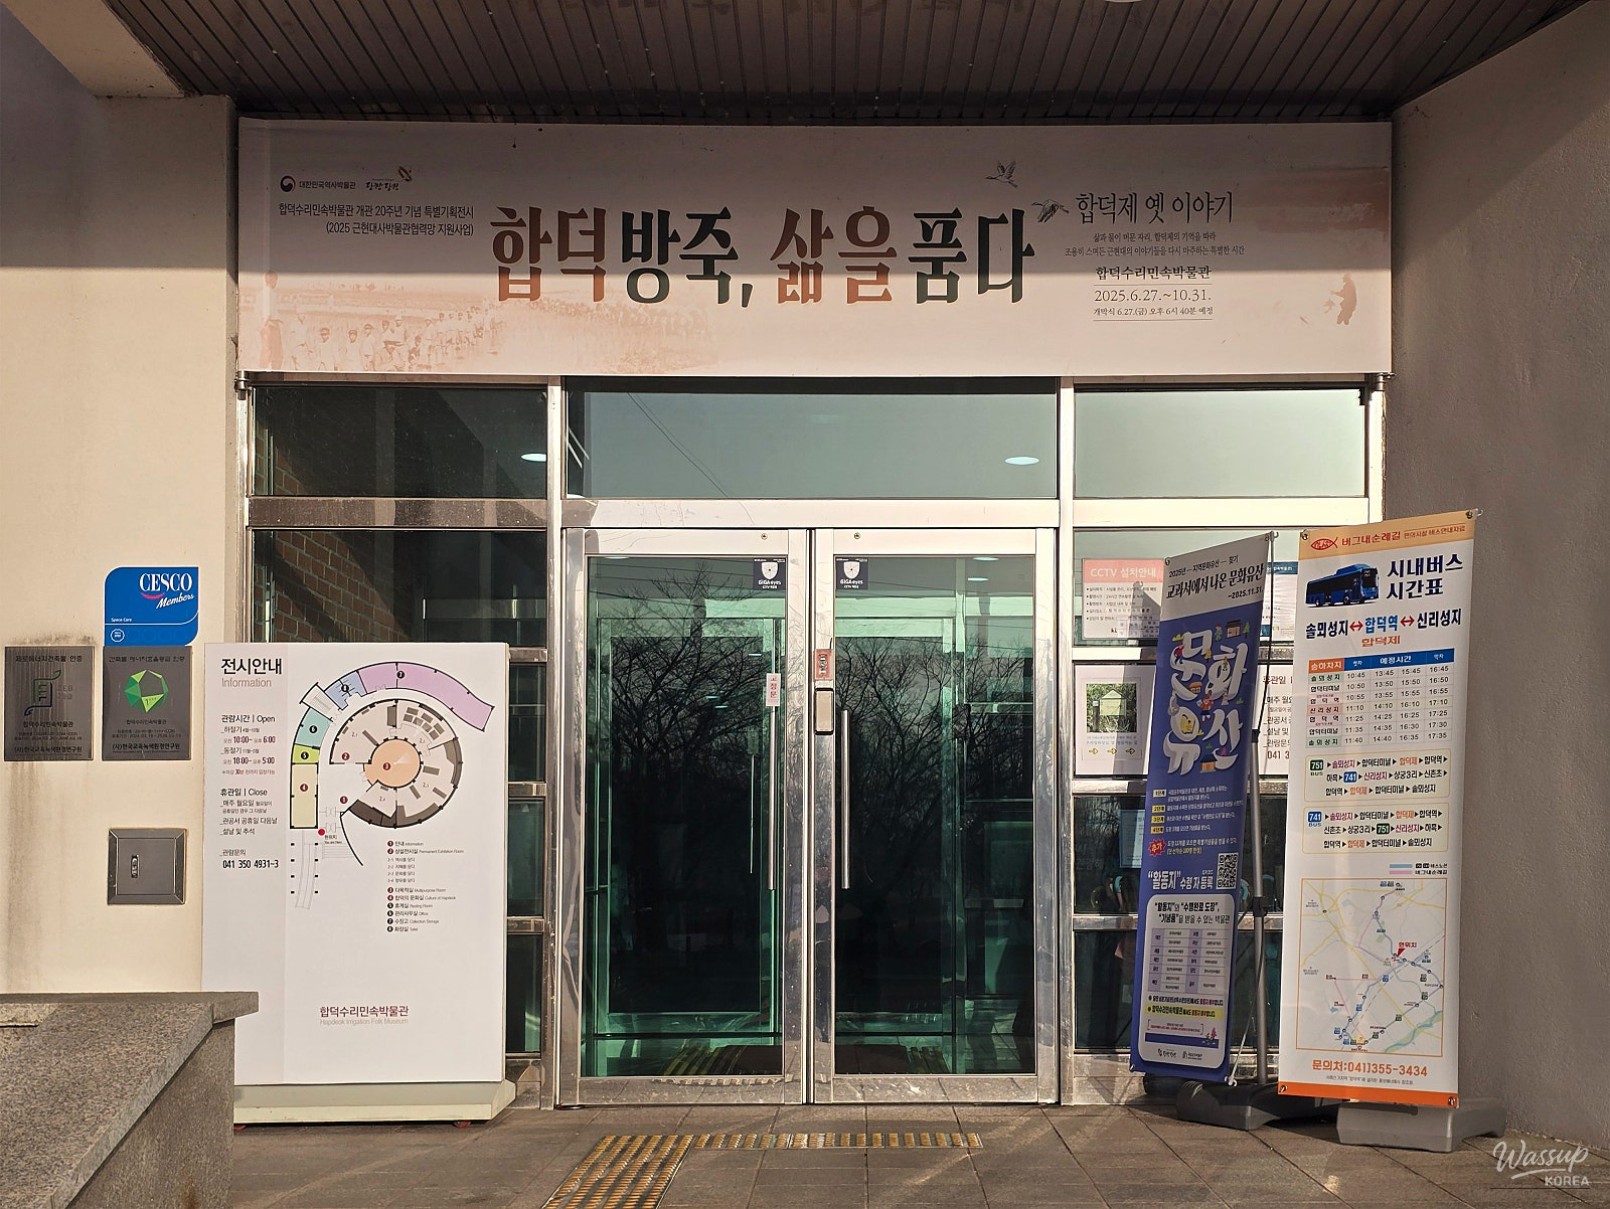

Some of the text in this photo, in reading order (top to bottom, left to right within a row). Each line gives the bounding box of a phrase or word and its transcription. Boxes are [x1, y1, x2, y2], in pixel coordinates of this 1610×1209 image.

[279, 203, 474, 219] 합덕수리민속박물관 개관 20주년 기념 특별기획전시
[1076, 191, 1233, 224] 합덕제 옛 이야기
[326, 222, 474, 236] (2025 근현대사박물관협력망 지원사업)
[490, 205, 1035, 308] 합덕방죽, 삶을 품다
[1096, 265, 1212, 280] 합덕수리민속박물관
[1094, 289, 1212, 302] 2025.6.27.~10.31.
[1166, 307, 1178, 316] 6시
[1342, 531, 1400, 546] 버그내순례길
[1169, 567, 1187, 577] 2025년
[1386, 554, 1463, 578] 시내버스
[1090, 567, 1157, 578] CCTV 설치안내
[139, 572, 193, 592] CESCO
[1166, 563, 1264, 599] 교과서에서 나온 문화유산
[1386, 577, 1443, 600] 시간표
[156, 592, 195, 609] Members
[1306, 608, 1462, 639] 솔뫼성지 합덕역 신리성지
[1362, 636, 1400, 648] 합덕제
[1379, 656, 1411, 664] 예정시간
[221, 658, 282, 675] 전시안내
[1170, 628, 1249, 706] 문화
[221, 678, 272, 688] Information
[257, 715, 275, 725] Open
[1163, 705, 1243, 776] 유산
[1268, 751, 1281, 759] 041
[1362, 759, 1391, 767] 합덕터미널
[1424, 755, 1442, 764] 합덕역
[1344, 772, 1357, 781] 741
[221, 788, 268, 797] 휴관일 Close
[1325, 788, 1342, 796] 합덕역
[1375, 785, 1404, 794] 합덕터미널
[1309, 813, 1321, 821] 741
[1360, 811, 1388, 820] 합덕터미널
[1419, 810, 1437, 818] 합덕역
[1377, 825, 1389, 833] 751
[1324, 840, 1341, 848] 합덕역
[1372, 839, 1401, 847] 합덕터미널
[223, 860, 279, 868] 041 350 4931~3
[320, 1006, 409, 1017] 합덕수리민속박물관
